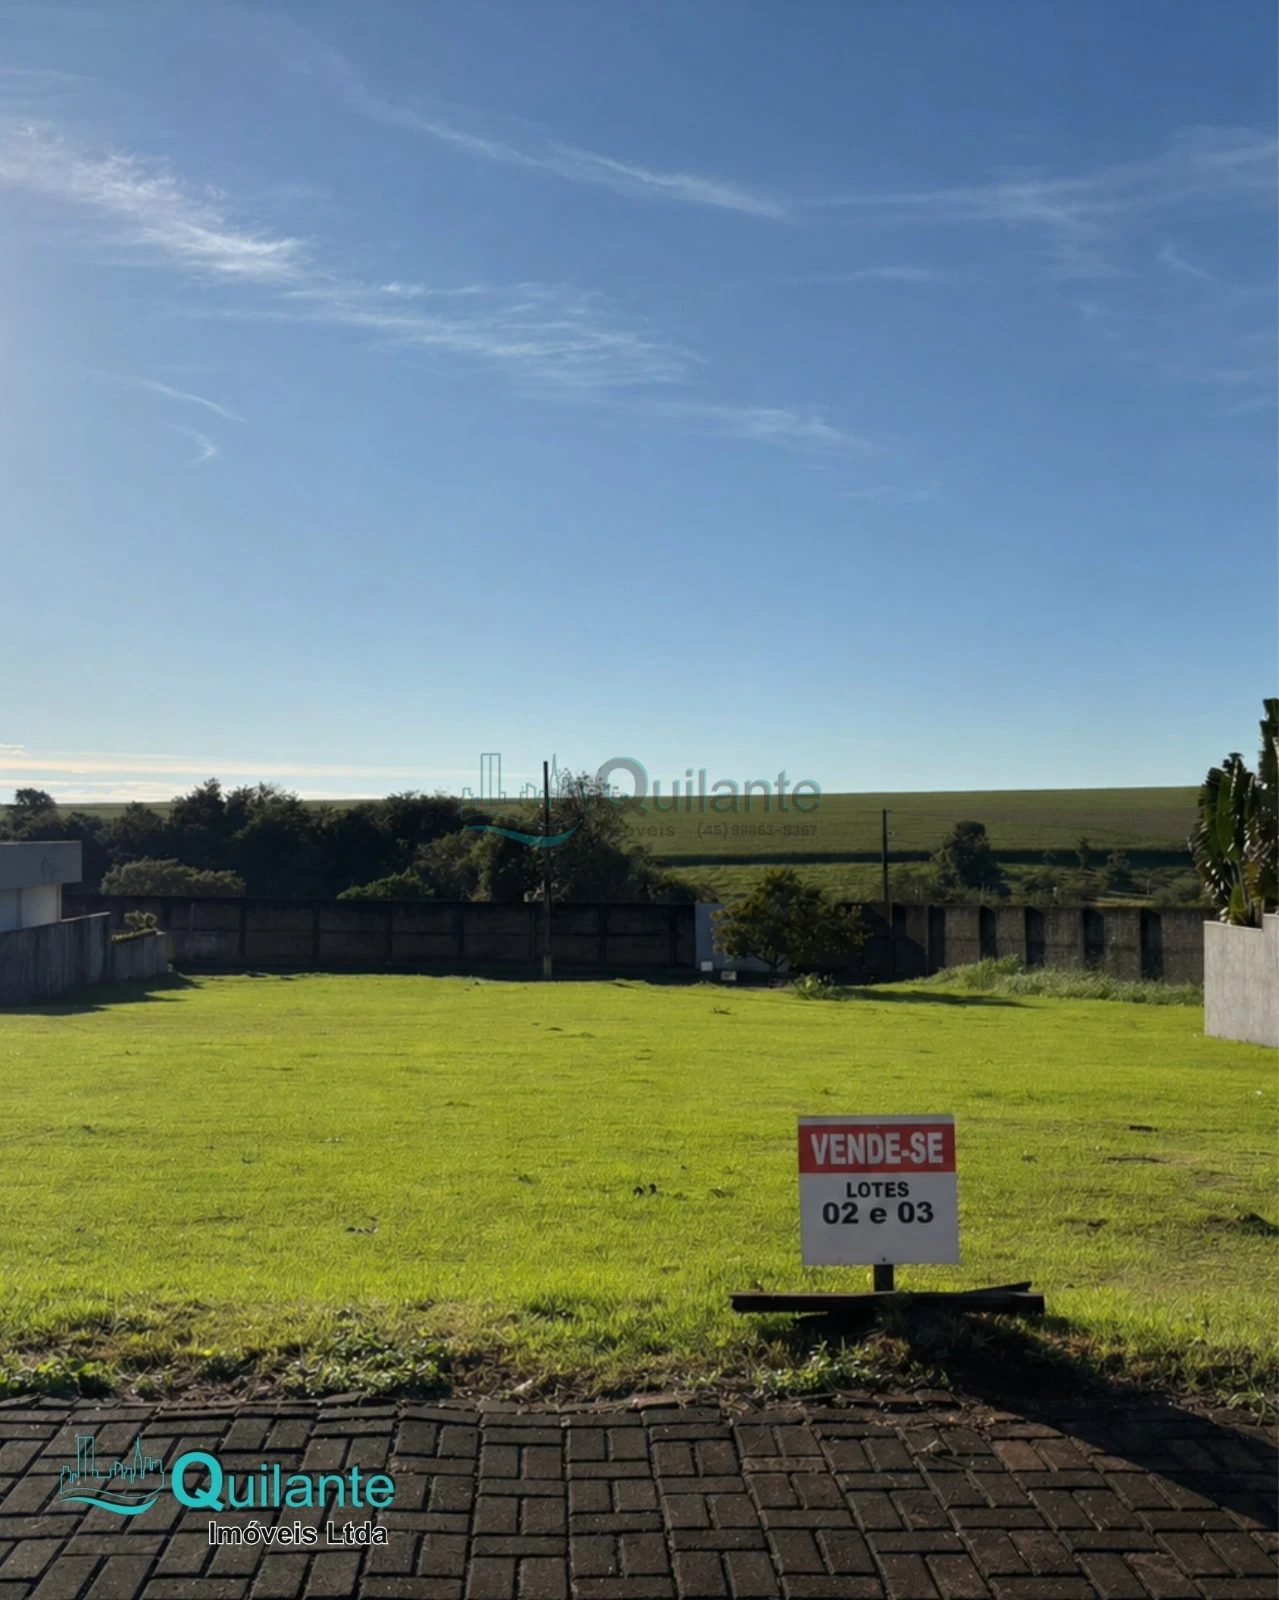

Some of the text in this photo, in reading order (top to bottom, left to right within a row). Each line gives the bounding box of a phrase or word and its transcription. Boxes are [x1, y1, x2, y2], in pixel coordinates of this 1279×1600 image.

[811, 1132, 944, 1165] VENDE-SE
[846, 1182, 909, 1198] LOTES
[822, 1201, 934, 1224] 02 e 03
